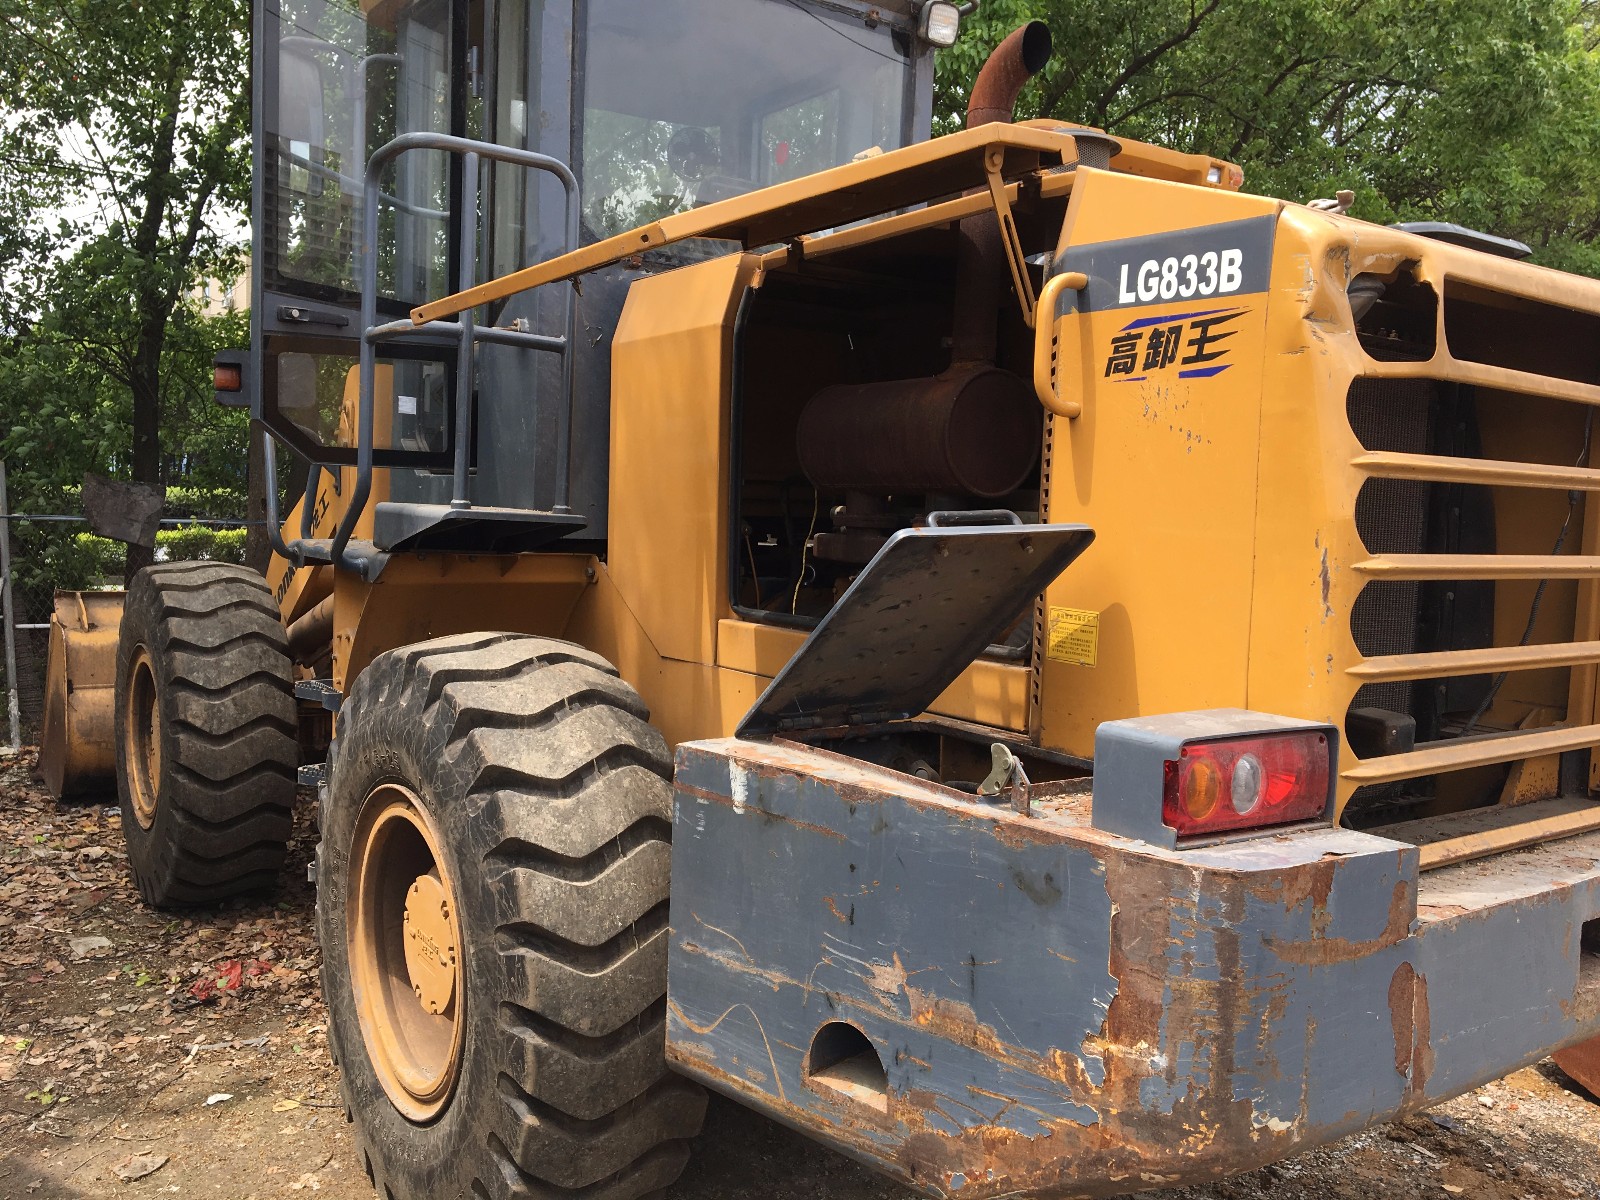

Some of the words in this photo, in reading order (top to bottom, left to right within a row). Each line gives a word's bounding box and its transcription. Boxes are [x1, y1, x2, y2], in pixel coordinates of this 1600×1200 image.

[1118, 248, 1244, 304] LG833B
[1103, 308, 1254, 378] 高卸王
